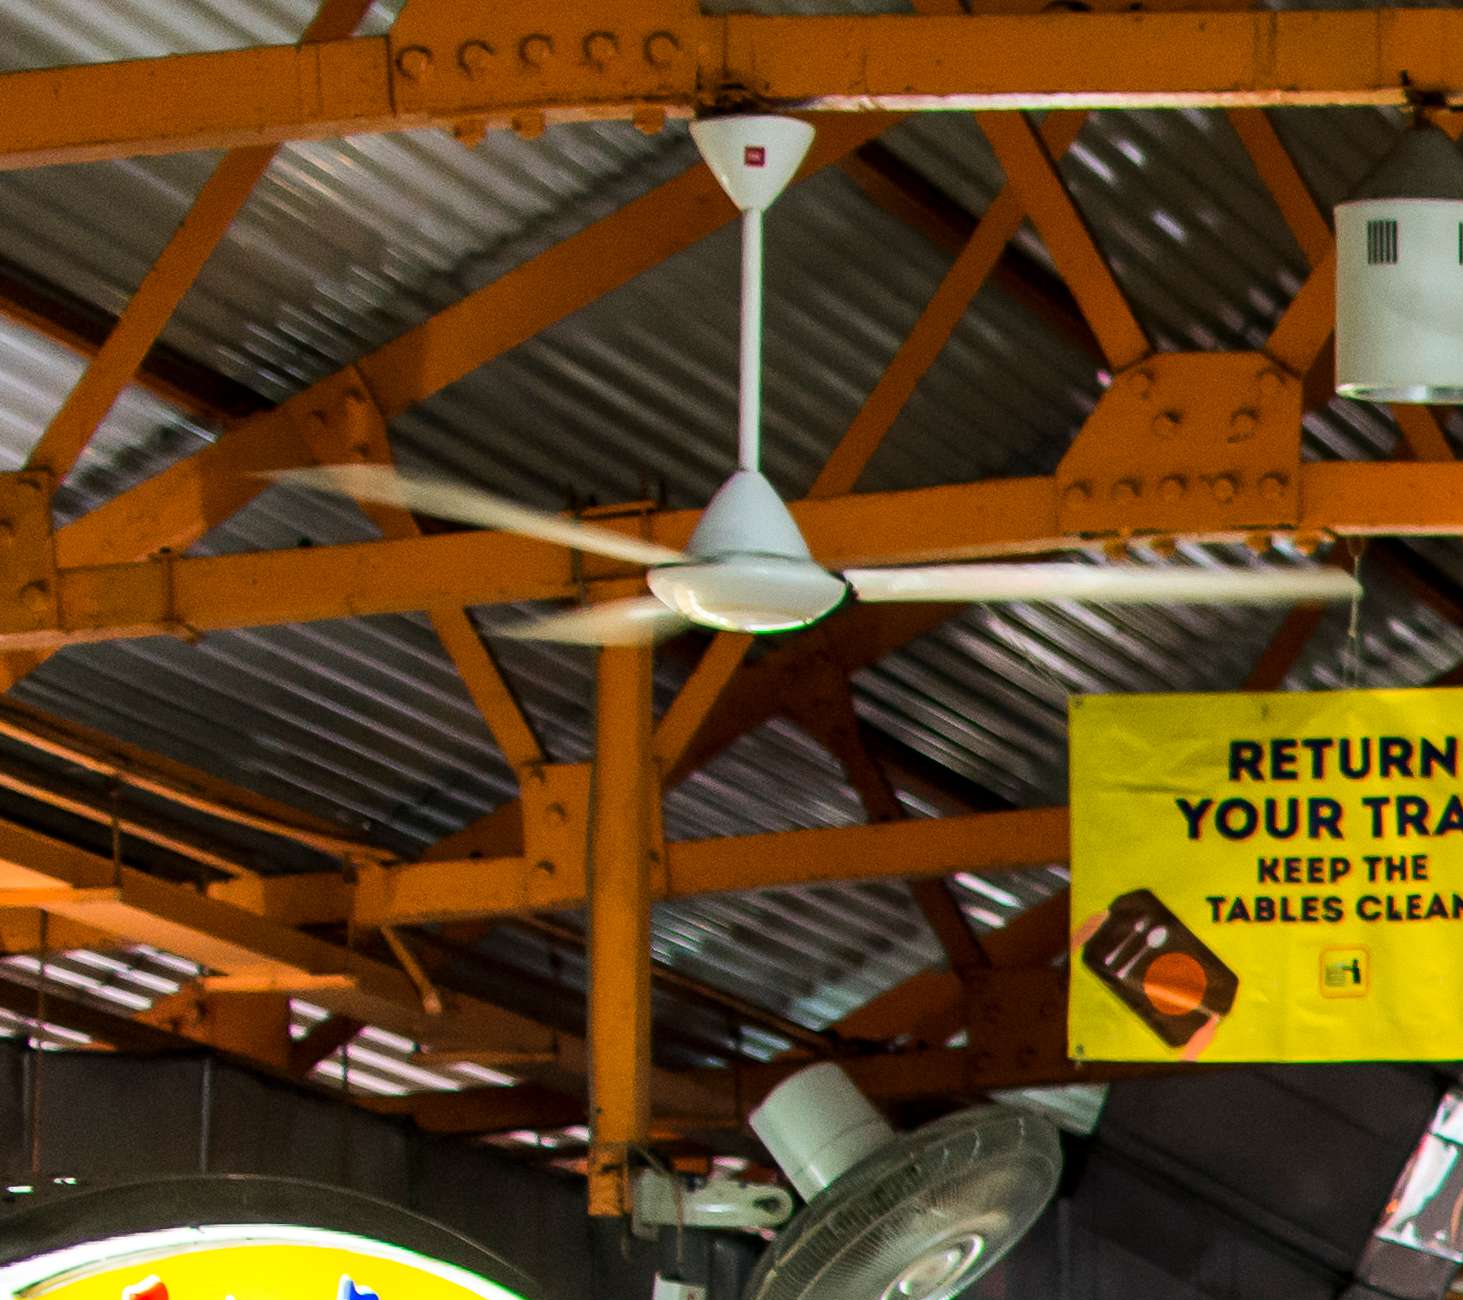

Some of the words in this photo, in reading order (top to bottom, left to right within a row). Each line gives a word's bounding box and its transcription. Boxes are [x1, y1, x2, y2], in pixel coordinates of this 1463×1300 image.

[1227, 736, 1459, 781] RETURN
[1174, 796, 1345, 842] YOUR
[1257, 856, 1350, 885] KEEP
[1363, 854, 1430, 882] THE
[1206, 895, 1344, 923] TABLES
